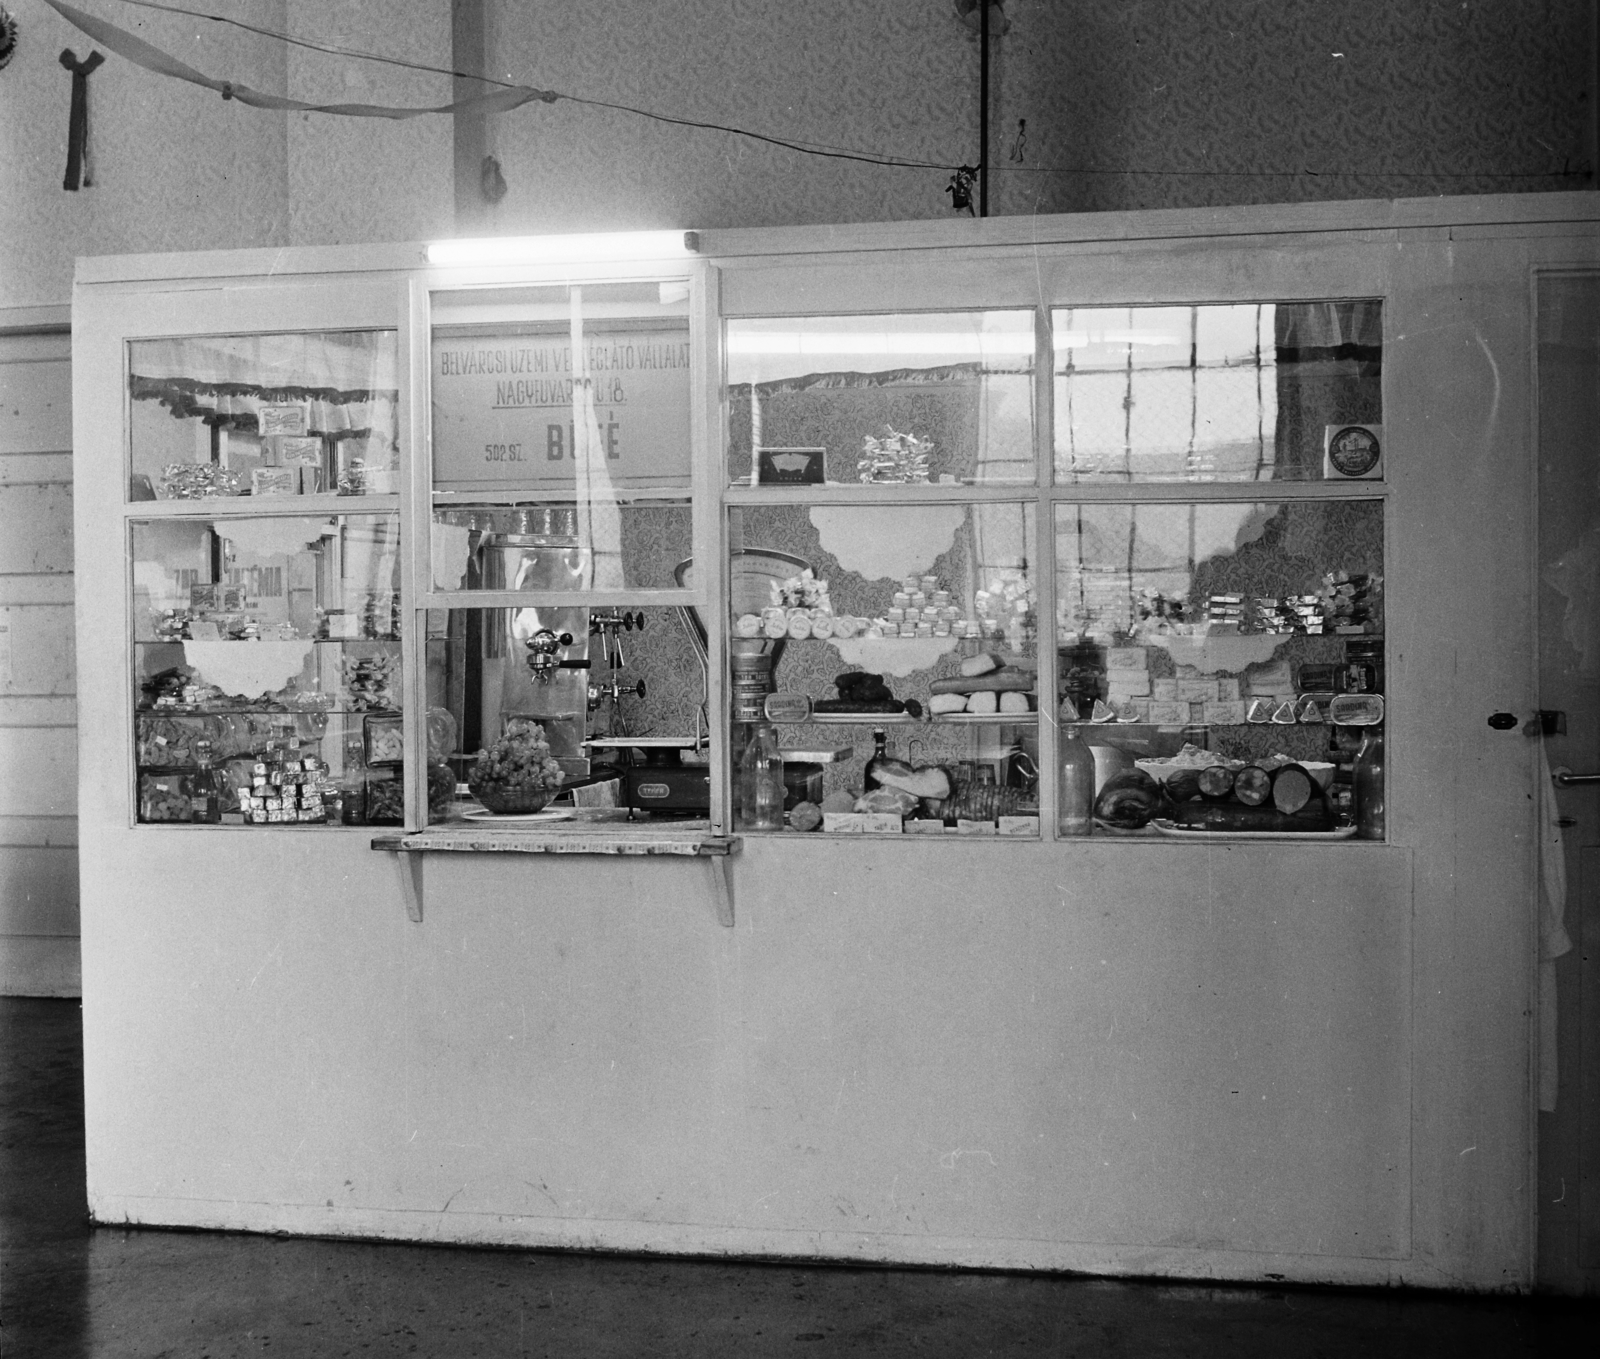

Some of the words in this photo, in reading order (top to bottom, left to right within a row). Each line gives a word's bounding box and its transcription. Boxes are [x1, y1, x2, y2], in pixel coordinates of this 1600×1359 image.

[552, 338, 634, 373] VEÉGLÁTÓ
[496, 378, 592, 405] NAGYFUVAR
[547, 411, 620, 460] BÉ
